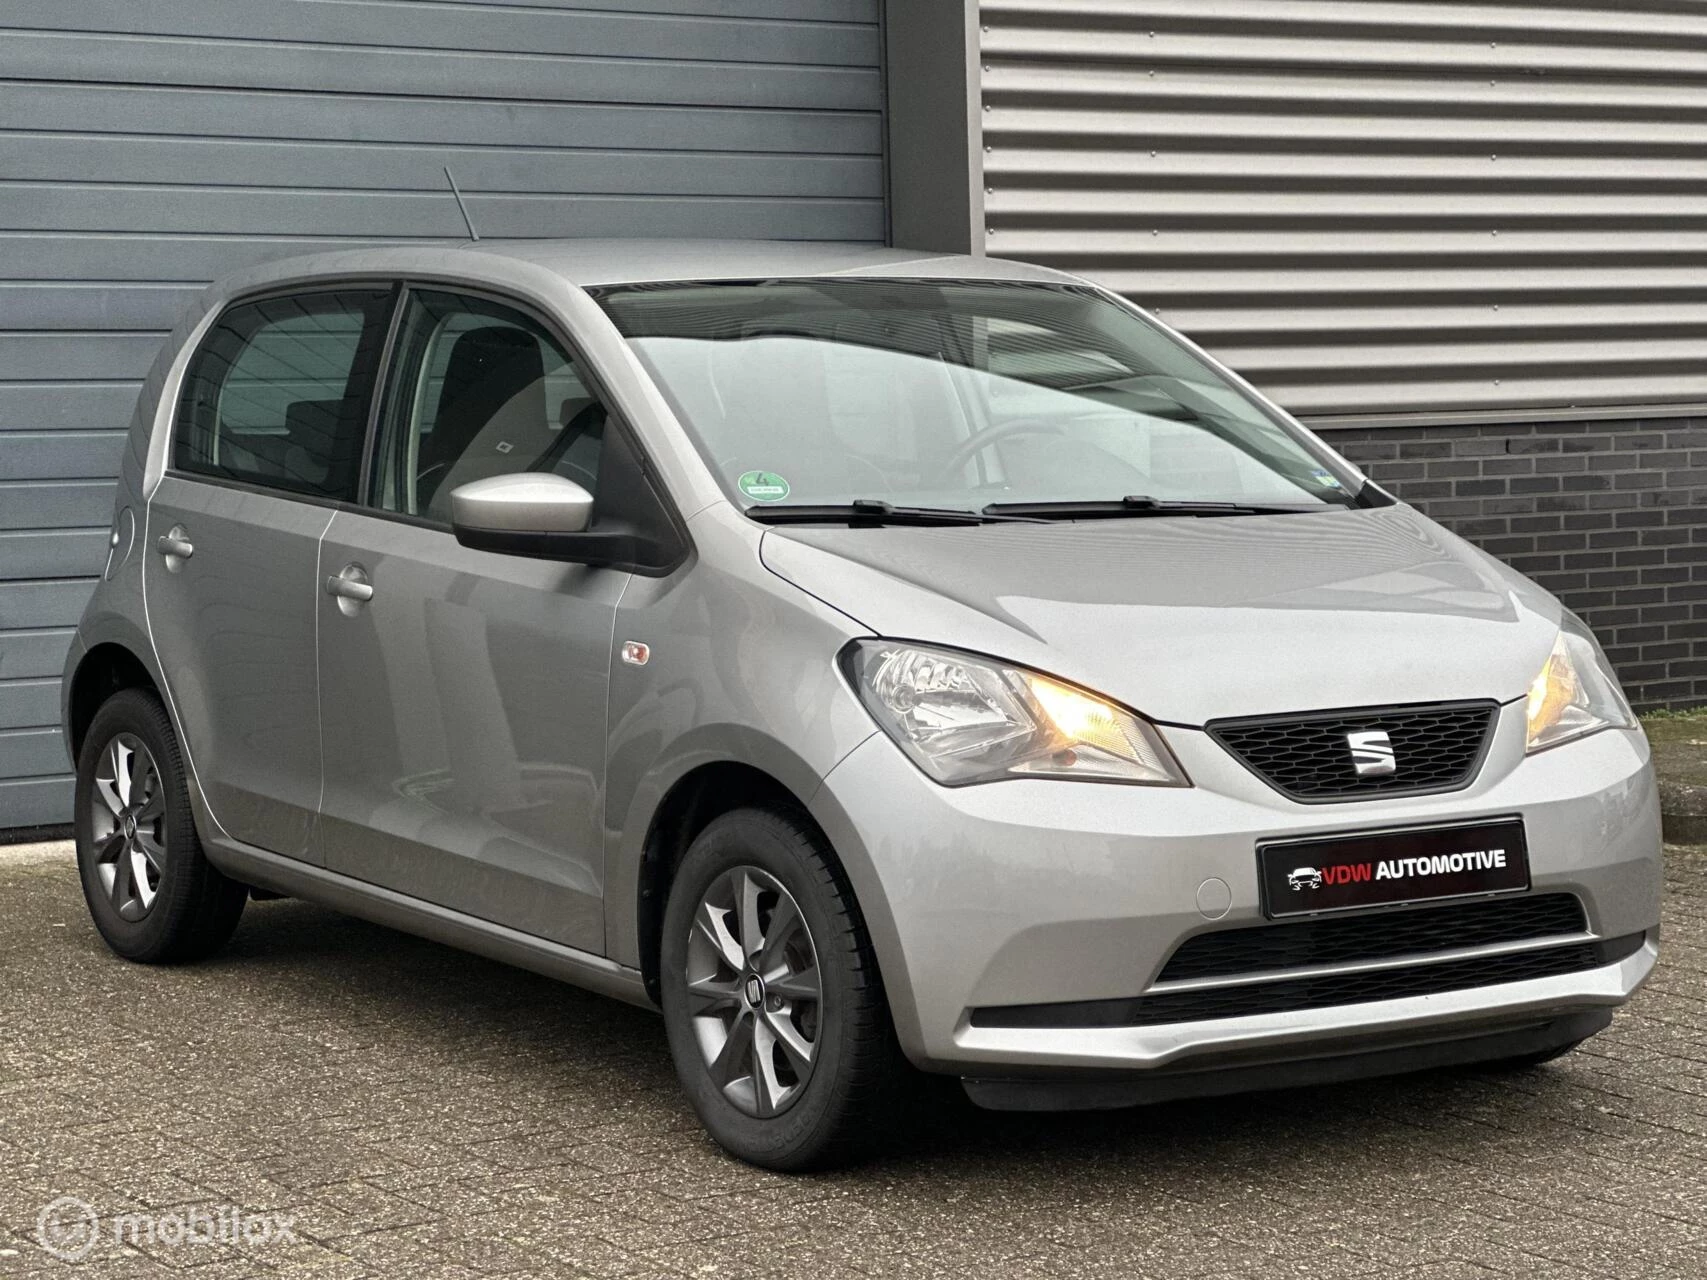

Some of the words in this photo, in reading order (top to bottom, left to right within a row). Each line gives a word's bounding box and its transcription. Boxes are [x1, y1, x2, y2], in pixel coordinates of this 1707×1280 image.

[756, 472, 769, 486] 4
[1322, 863, 1372, 885] VDW
[1375, 849, 1507, 880] AUTOMOTIVE
